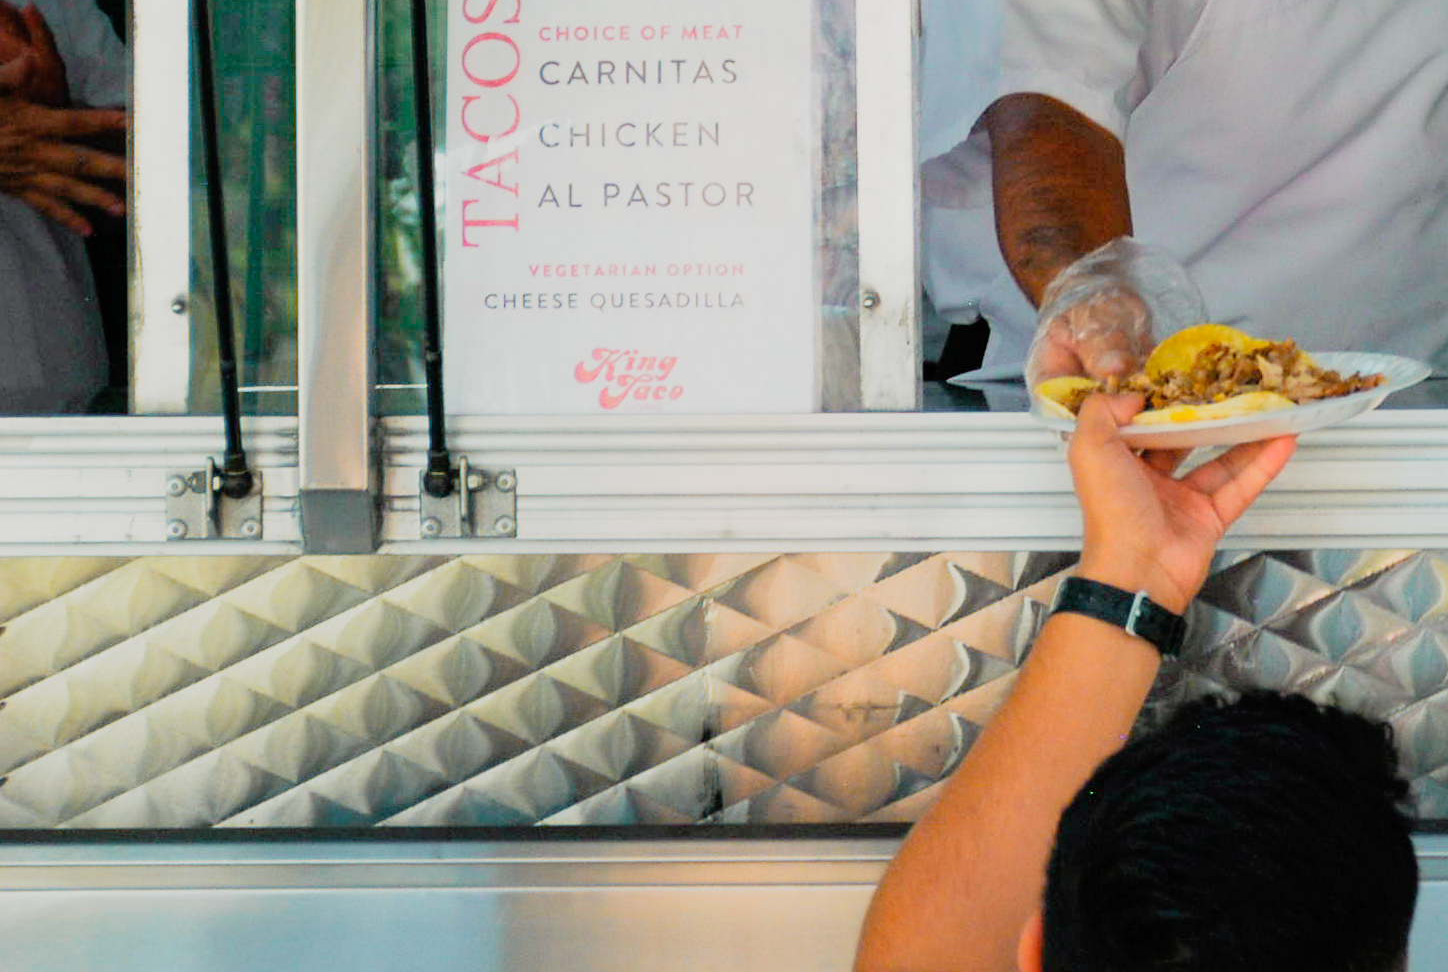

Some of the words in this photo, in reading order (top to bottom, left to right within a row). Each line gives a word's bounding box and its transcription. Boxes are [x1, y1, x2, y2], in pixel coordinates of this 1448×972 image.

[538, 25, 631, 42] CHOICE
[641, 25, 671, 42] OF
[680, 24, 744, 41] MEAT
[538, 59, 739, 87] CARNITAS
[538, 122, 721, 149] CHICKEN
[537, 183, 583, 209] AL
[603, 181, 756, 208] PASTOR
[528, 264, 658, 278] VEGETARIAN
[667, 263, 745, 277] OPTION
[484, 292, 580, 310] CHEESE
[589, 292, 745, 312] QUESADILLA
[574, 347, 679, 383] King
[598, 373, 684, 410] Taco
